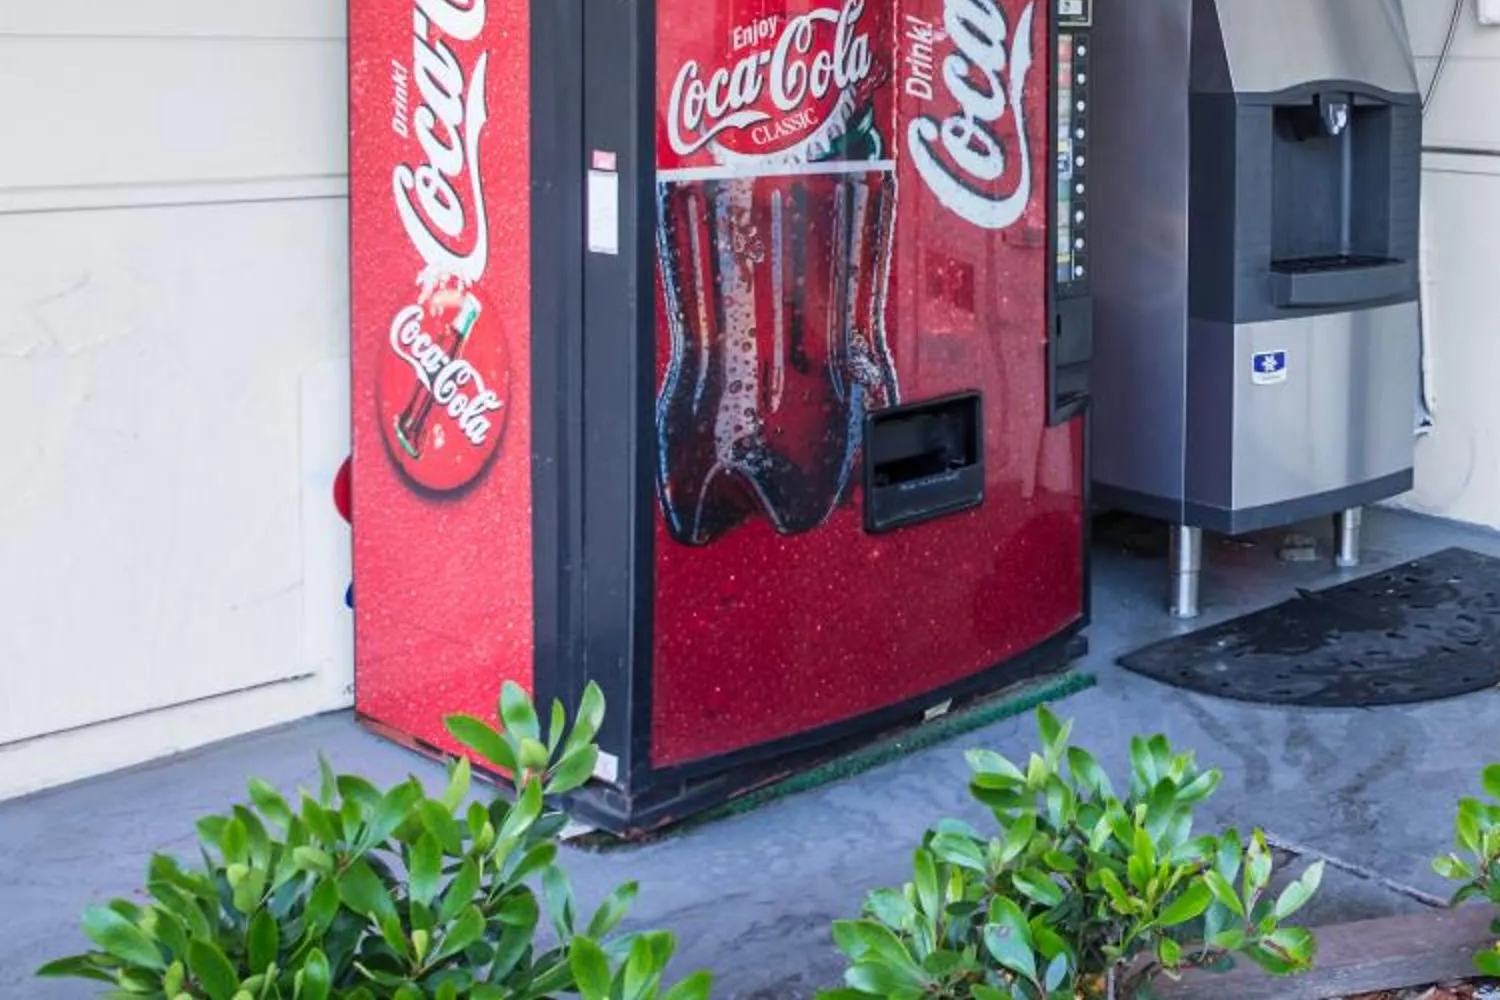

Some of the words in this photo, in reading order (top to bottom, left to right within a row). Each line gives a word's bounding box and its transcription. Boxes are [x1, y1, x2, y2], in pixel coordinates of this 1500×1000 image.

[732, 13, 779, 51] Enjoy
[751, 107, 819, 146] CLASSIC
[389, 303, 504, 445] Coca-Cola
